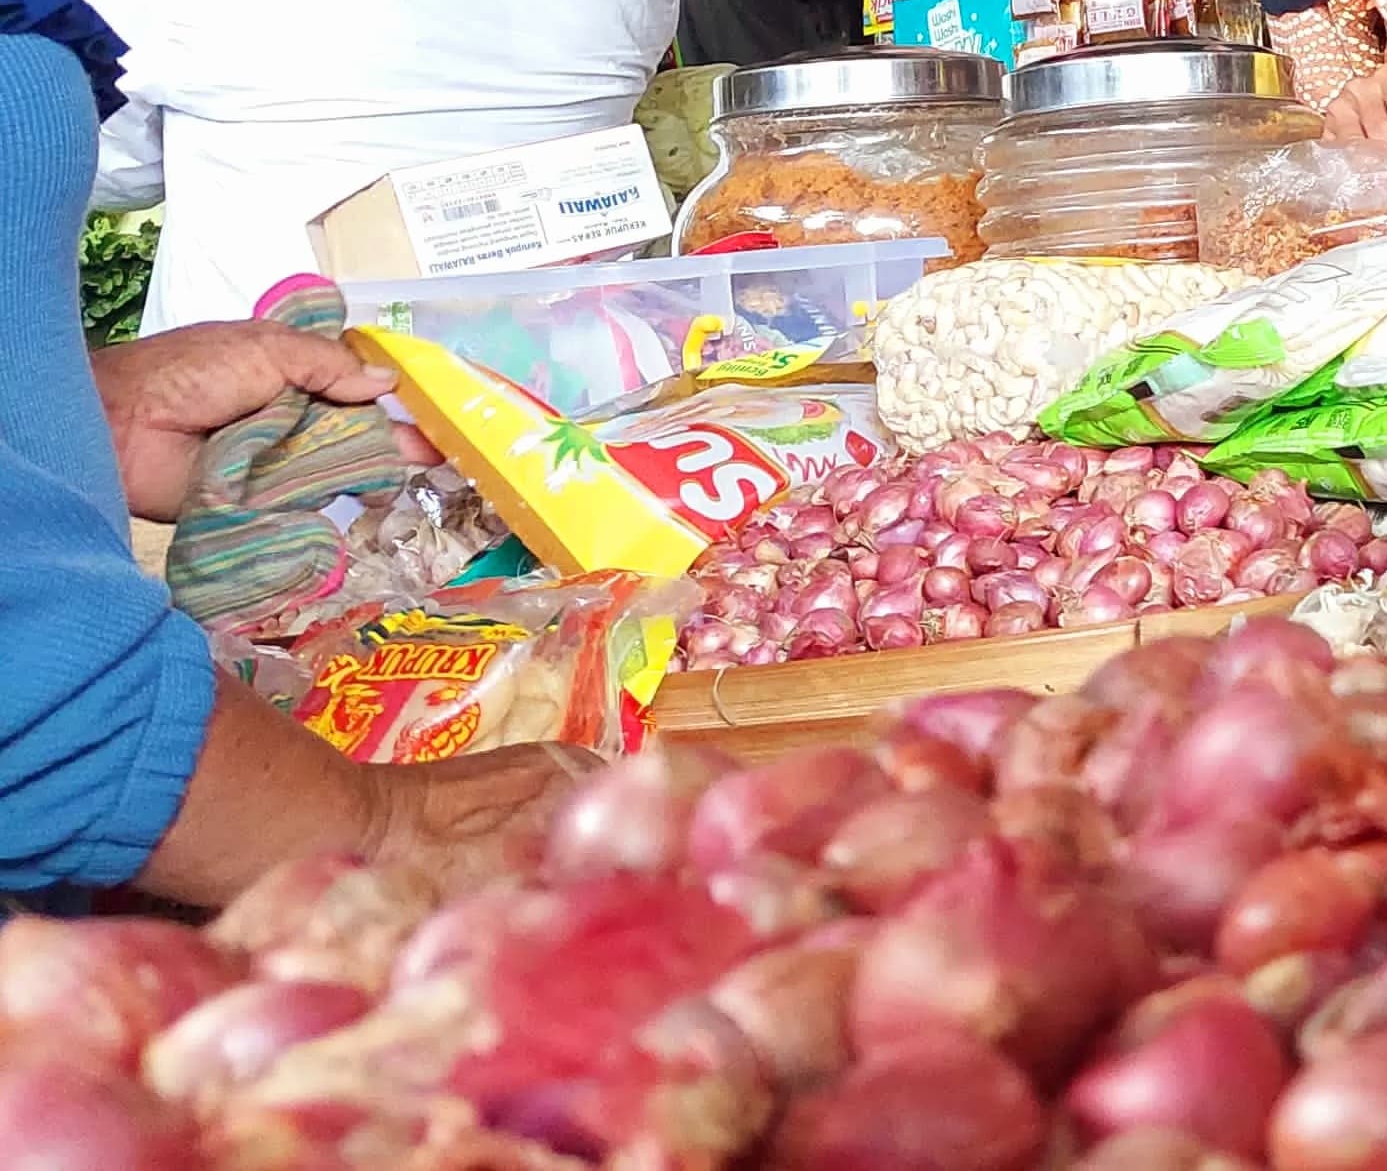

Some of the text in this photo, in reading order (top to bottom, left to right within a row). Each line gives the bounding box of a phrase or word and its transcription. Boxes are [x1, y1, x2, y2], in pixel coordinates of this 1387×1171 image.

[558, 185, 641, 216] RAJAWALI
[600, 219, 648, 240] KERUPUK
[364, 643, 497, 681] KRUPUK
